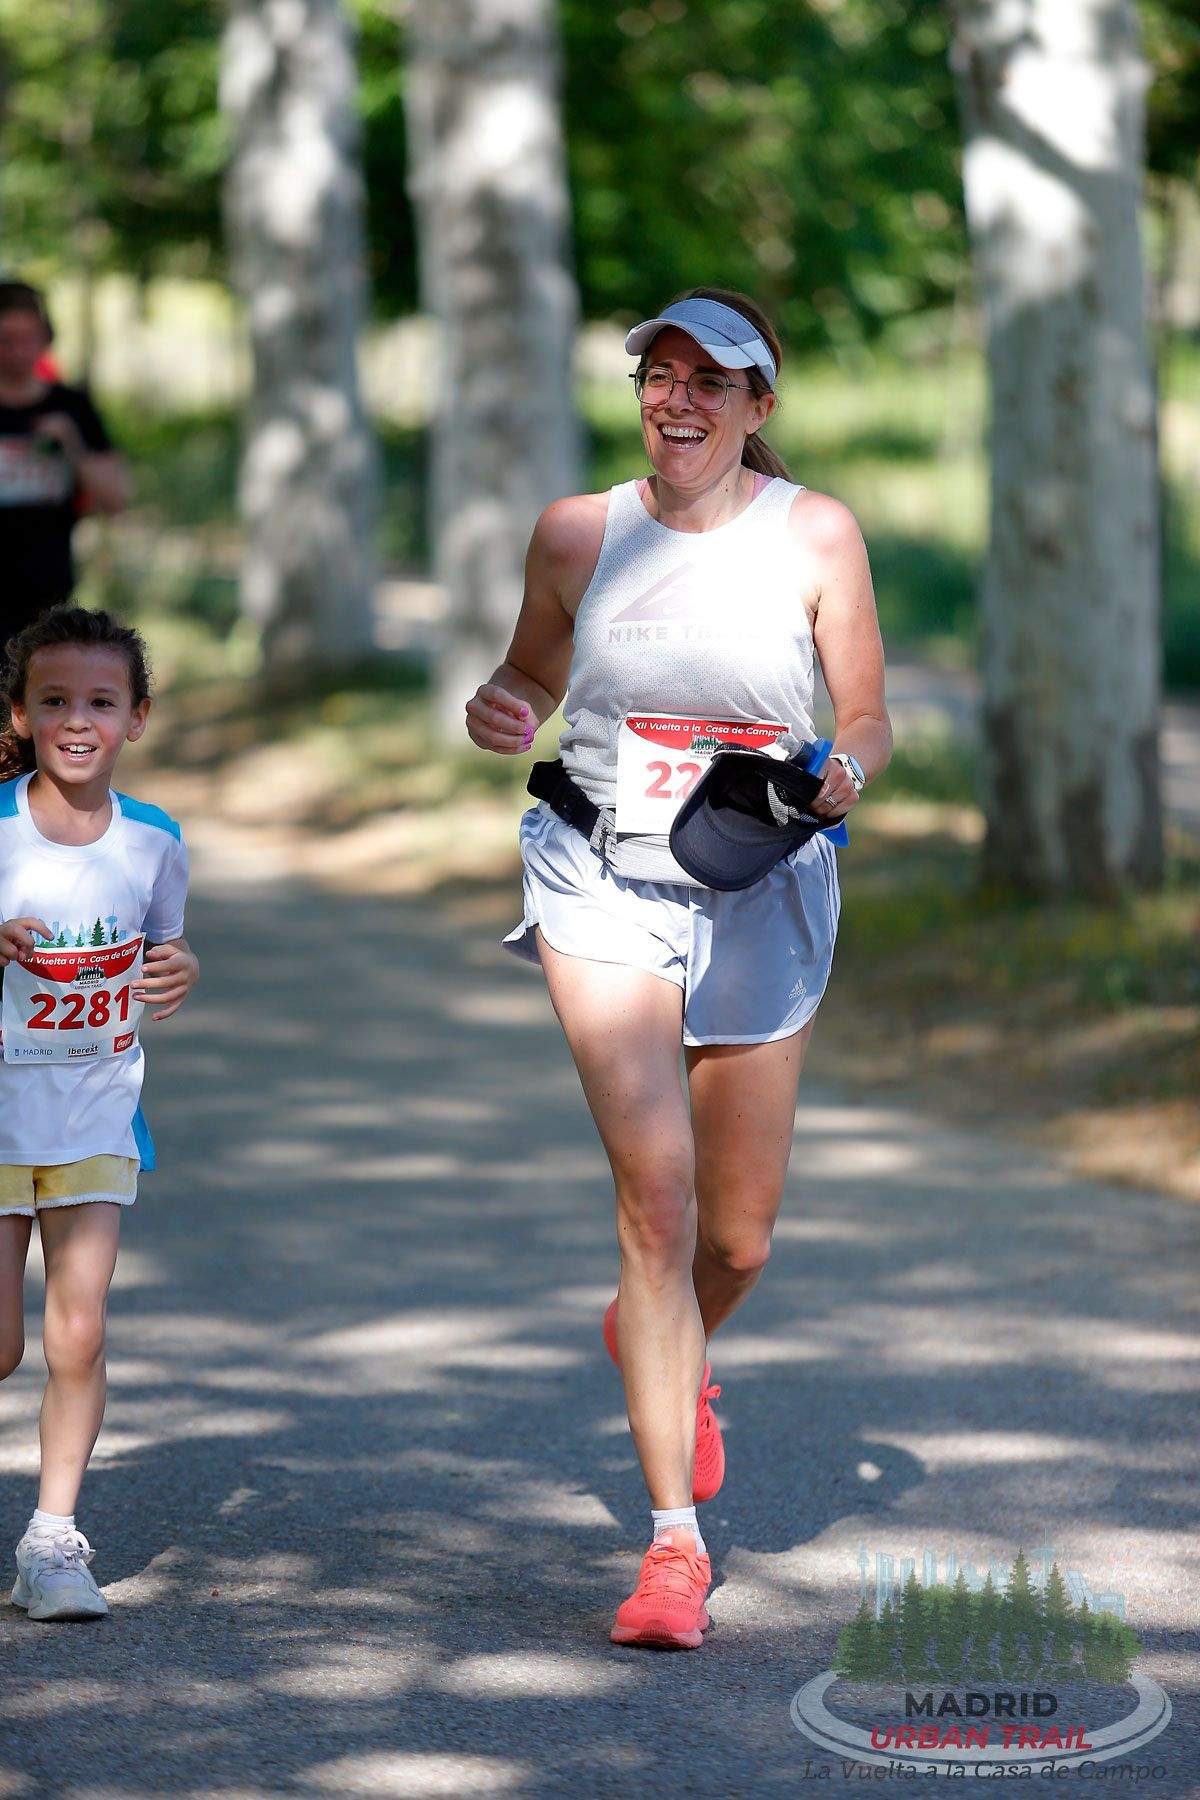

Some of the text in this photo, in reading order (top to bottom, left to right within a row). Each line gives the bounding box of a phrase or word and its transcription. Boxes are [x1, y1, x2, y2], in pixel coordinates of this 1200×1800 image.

[608, 627, 668, 643] NIKE
[634, 722, 647, 730] XII
[649, 723, 681, 732] Vuelta
[692, 724, 701, 732] la
[705, 725, 729, 734] Casa
[732, 727, 743, 735] de
[746, 728, 780, 737] Campo
[36, 956, 66, 965] Vuelta
[90, 954, 109, 963] Casa
[111, 952, 121, 960] de
[122, 945, 138, 956] Camp
[27, 985, 130, 1030] 2281
